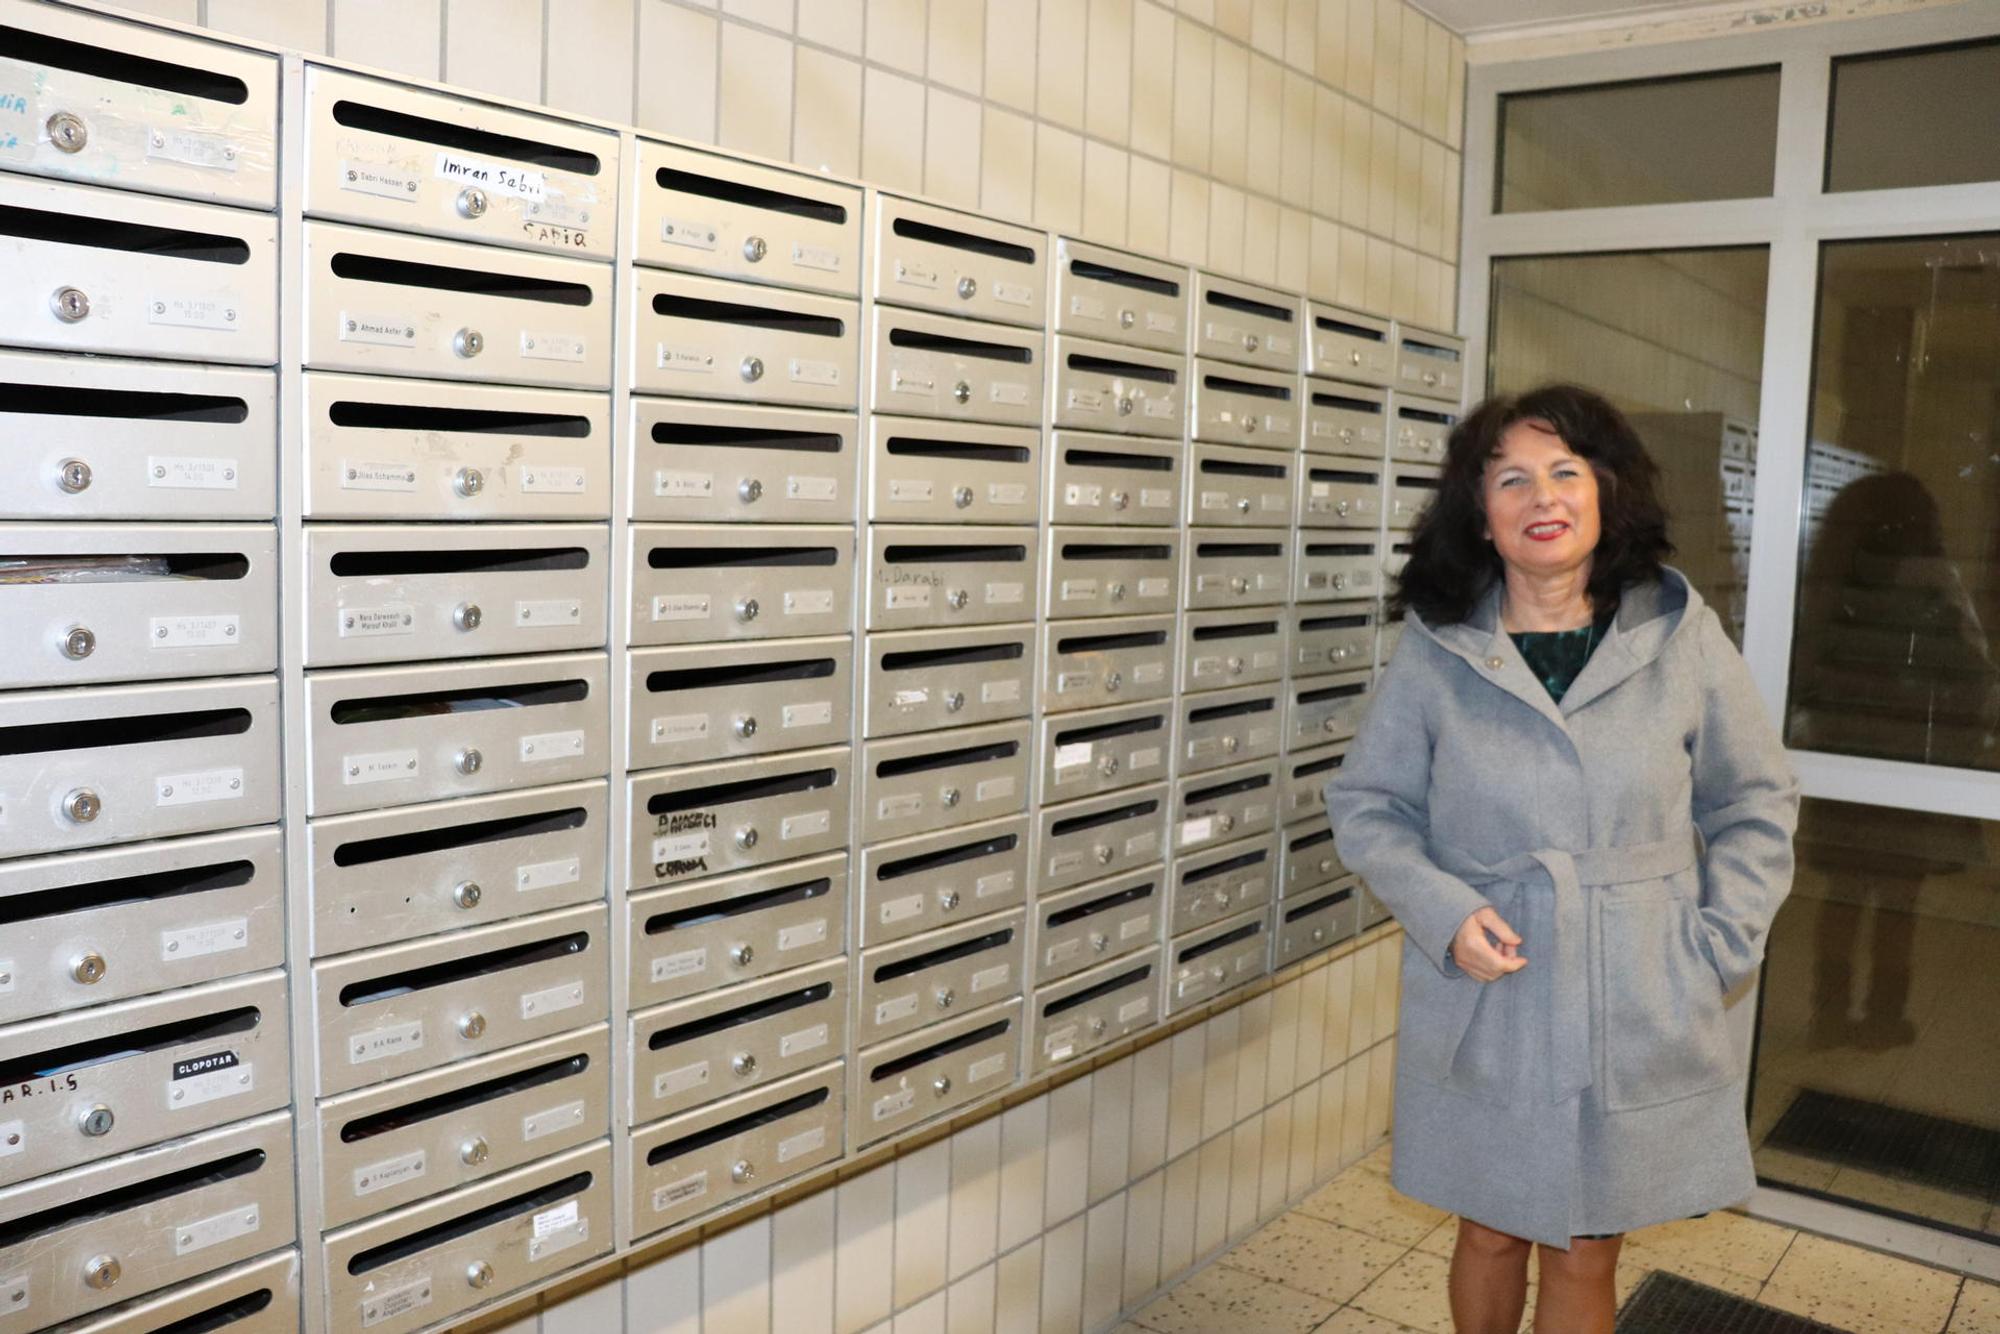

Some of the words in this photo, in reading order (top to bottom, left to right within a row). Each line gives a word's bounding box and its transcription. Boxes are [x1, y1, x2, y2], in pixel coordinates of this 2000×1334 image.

[442, 157, 488, 182] Imran
[498, 170, 541, 195] Sabri
[178, 1054, 233, 1074] CLOPOTAR
